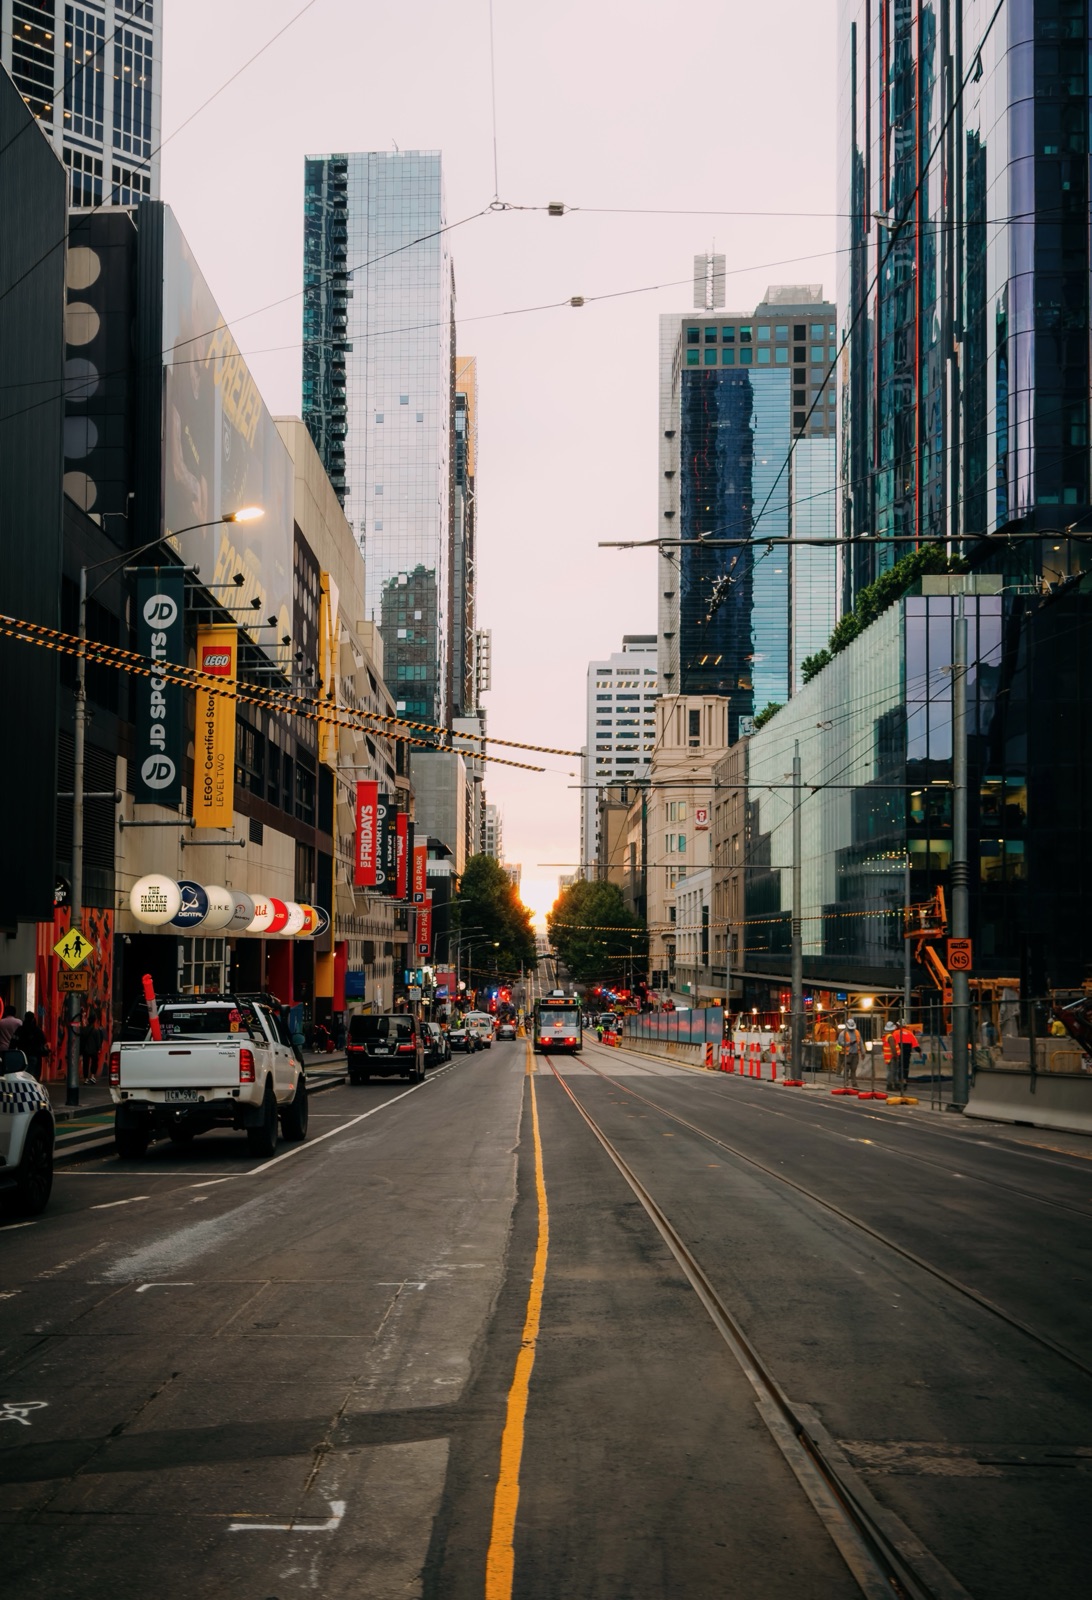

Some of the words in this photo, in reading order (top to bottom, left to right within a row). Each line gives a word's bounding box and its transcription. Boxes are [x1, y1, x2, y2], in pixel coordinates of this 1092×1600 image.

[205, 313, 263, 449] FOREVER
[148, 603, 173, 620] JD
[203, 656, 229, 667] LEGO
[205, 691, 215, 718] Stor
[150, 724, 165, 751] JD
[204, 721, 214, 770] Certified
[146, 763, 171, 780] JD
[217, 753, 225, 778] TWO
[216, 779, 224, 807] LEVEL
[360, 804, 373, 860] FRIDAYS
[141, 895, 168, 904] PANCAKE
[148, 886, 160, 895] THE
[141, 904, 168, 913] PARLOUR
[953, 956, 967, 964] NS
